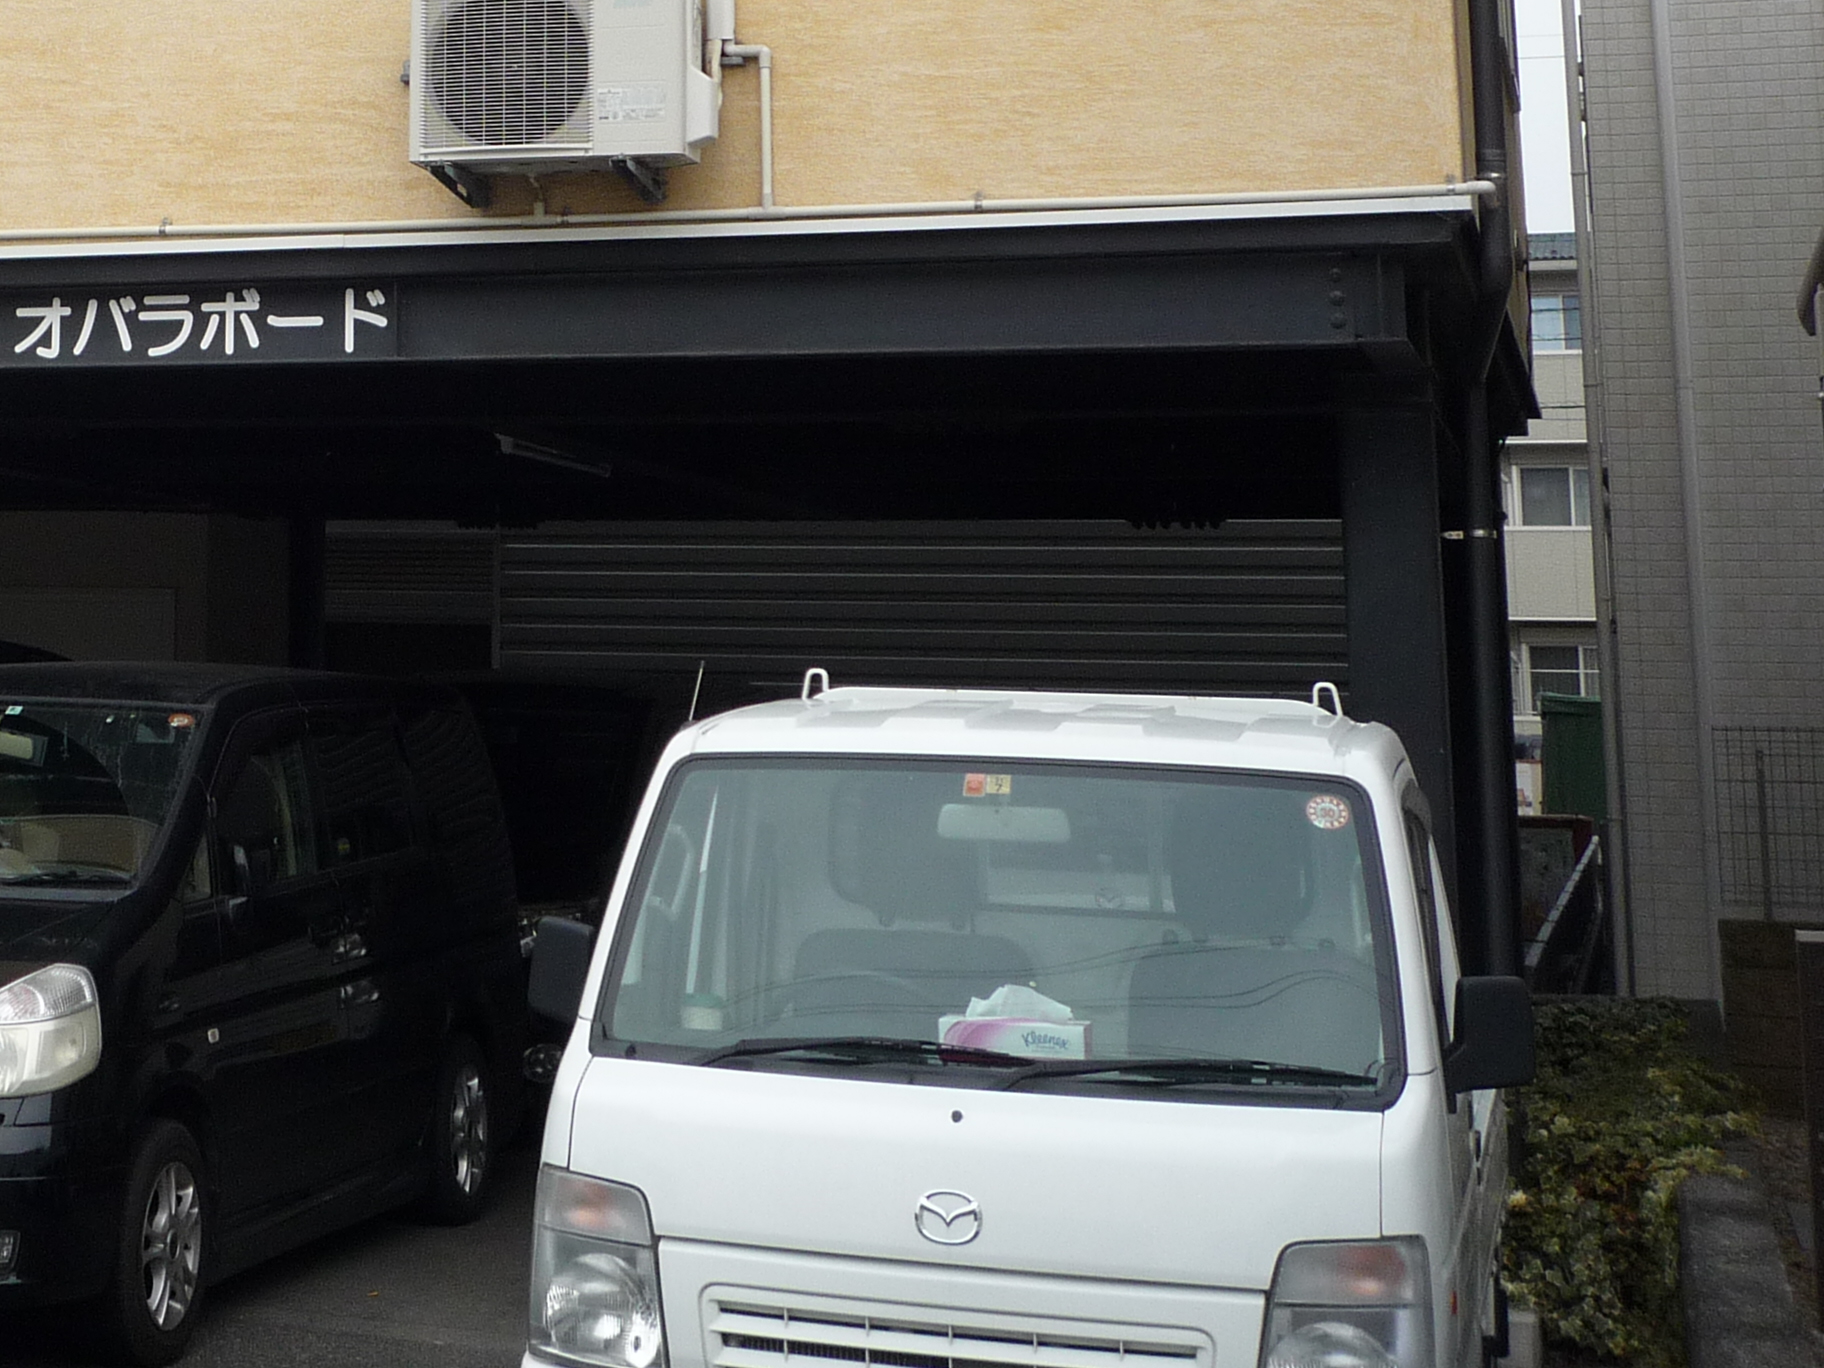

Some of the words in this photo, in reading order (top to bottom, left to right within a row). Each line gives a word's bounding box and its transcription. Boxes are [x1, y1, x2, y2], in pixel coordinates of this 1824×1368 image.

[14, 288, 388, 359] オバラボード
[1021, 1031, 1069, 1050] Kleenex
